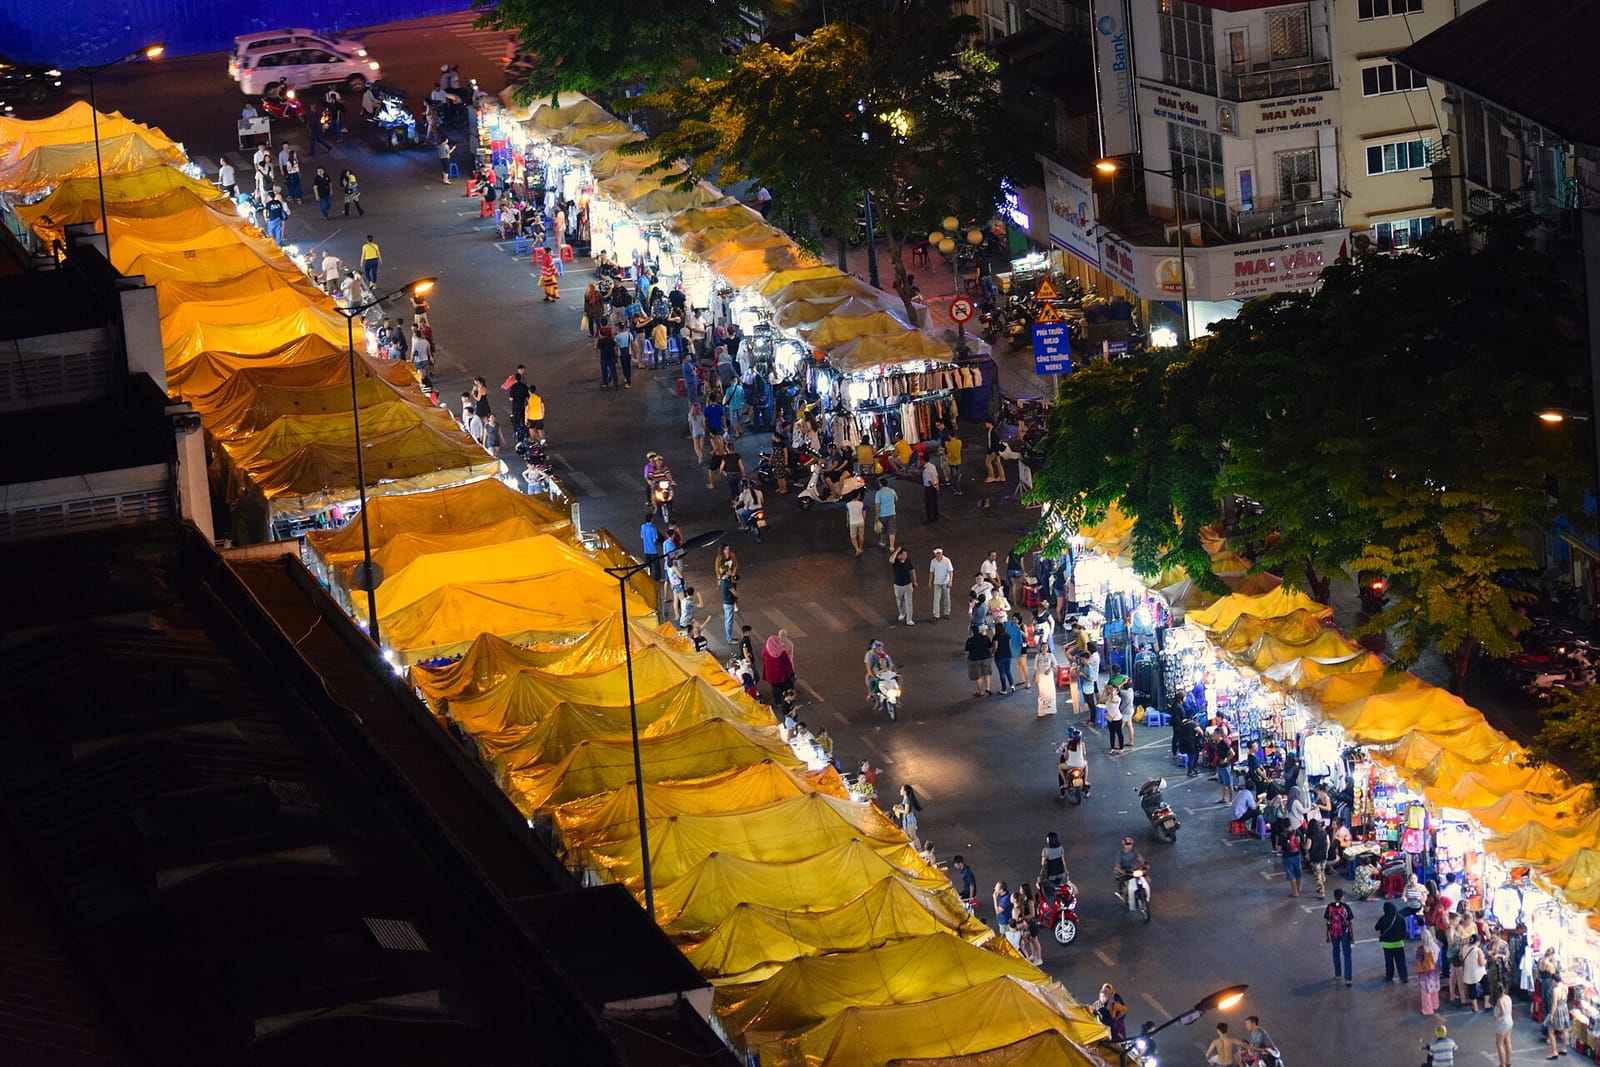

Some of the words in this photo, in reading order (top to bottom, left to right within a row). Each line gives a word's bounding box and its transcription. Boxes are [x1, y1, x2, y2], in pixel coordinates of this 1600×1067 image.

[1158, 96, 1177, 109] MAI
[1262, 110, 1287, 121] MAI
[1290, 105, 1317, 118] VÂN
[1234, 248, 1260, 257] DOANH
[1235, 257, 1276, 277] MAI
[1281, 249, 1324, 271] VÂN
